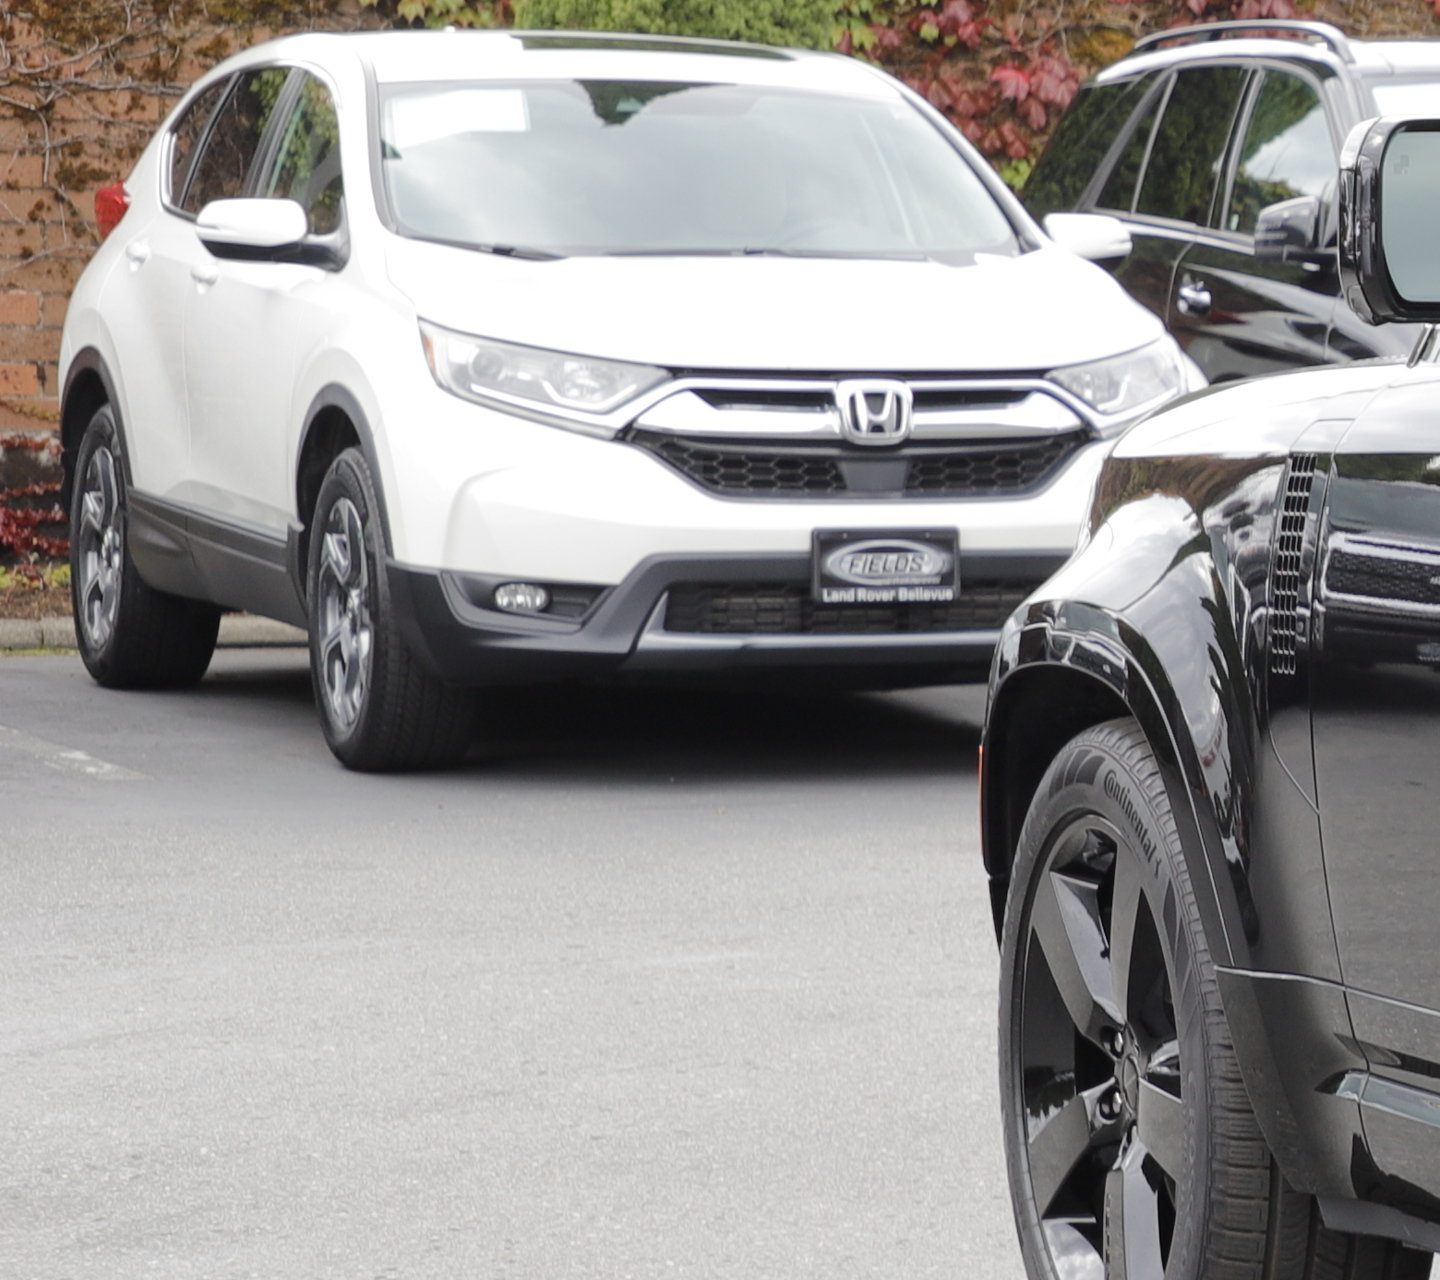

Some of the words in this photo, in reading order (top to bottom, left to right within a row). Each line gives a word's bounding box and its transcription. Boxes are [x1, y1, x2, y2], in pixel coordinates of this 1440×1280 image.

[848, 553, 926, 574] FIELDS
[822, 588, 854, 603] Land
[856, 588, 896, 602] Rover
[899, 587, 954, 602] Bellevue
[1103, 769, 1157, 863] Continental
